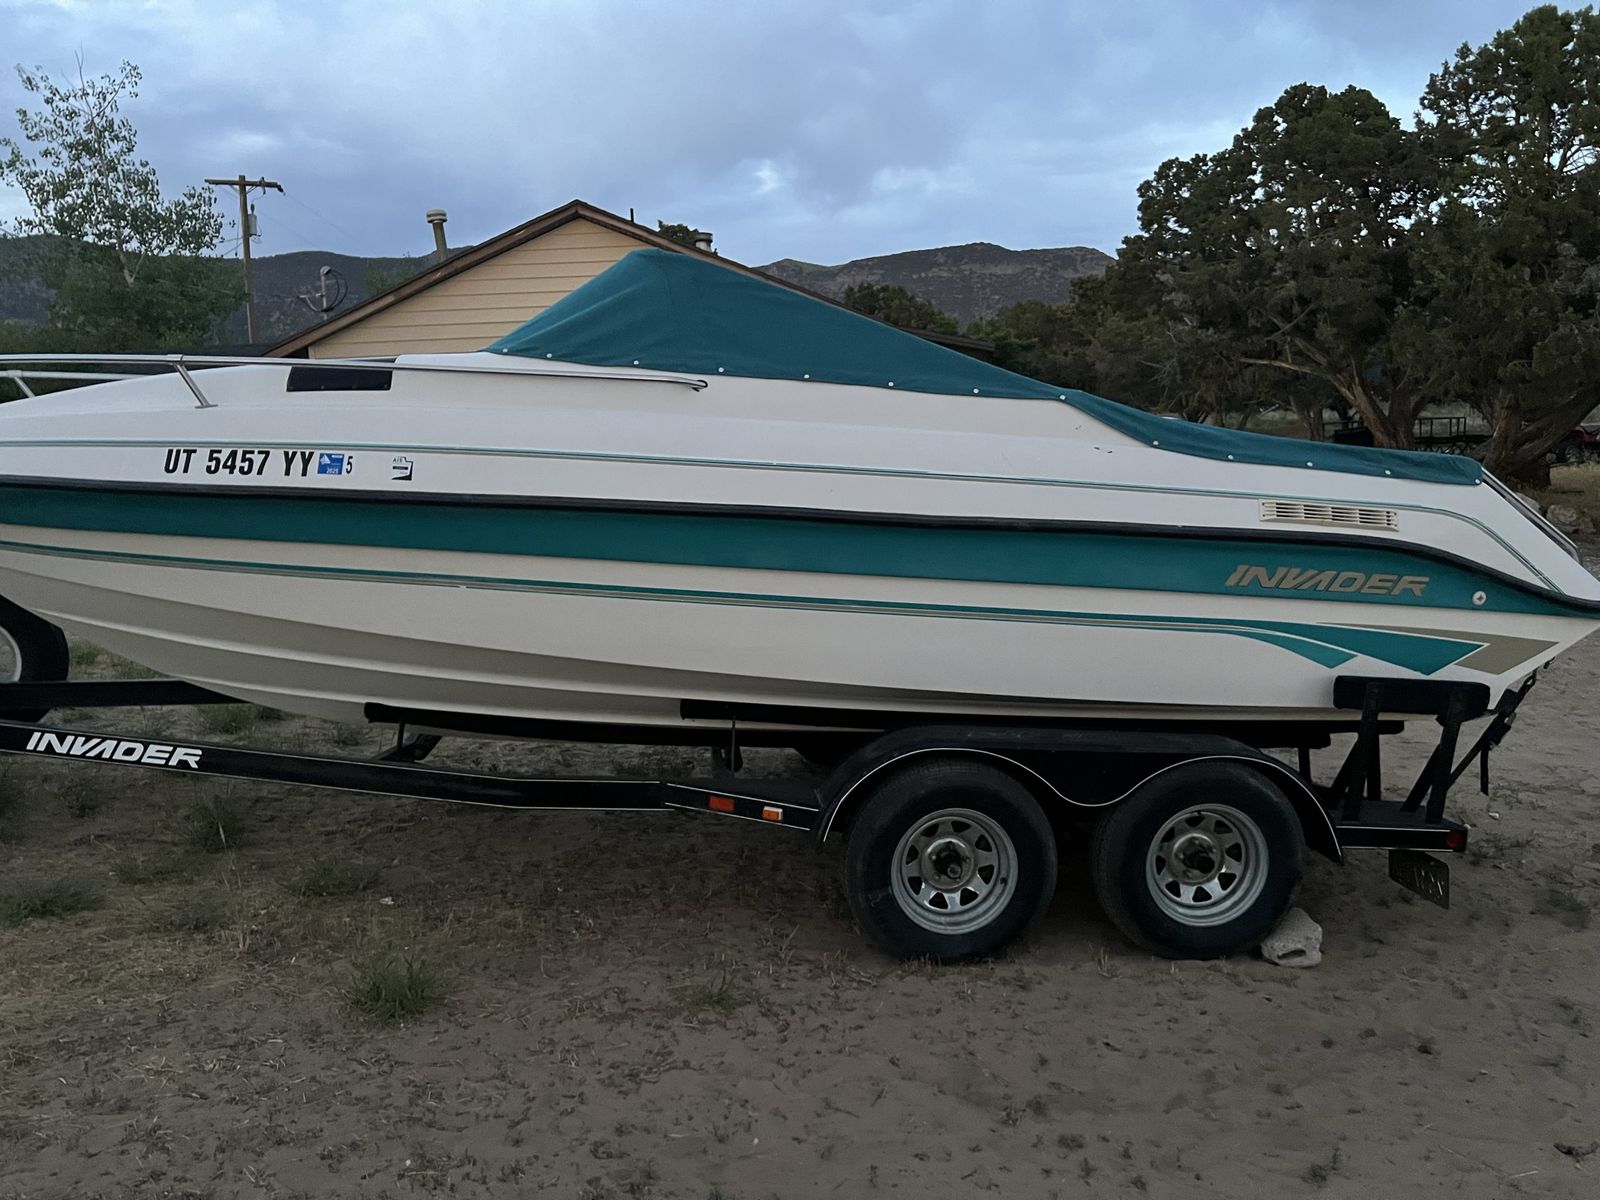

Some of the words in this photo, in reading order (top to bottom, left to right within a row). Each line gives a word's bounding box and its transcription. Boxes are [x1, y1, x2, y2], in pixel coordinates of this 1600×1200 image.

[164, 448, 197, 474] UT
[205, 449, 270, 475] 5457
[283, 451, 315, 477] YY
[345, 456, 353, 474] 5
[1225, 564, 1430, 597] INVADER
[26, 731, 203, 769] INVADER
